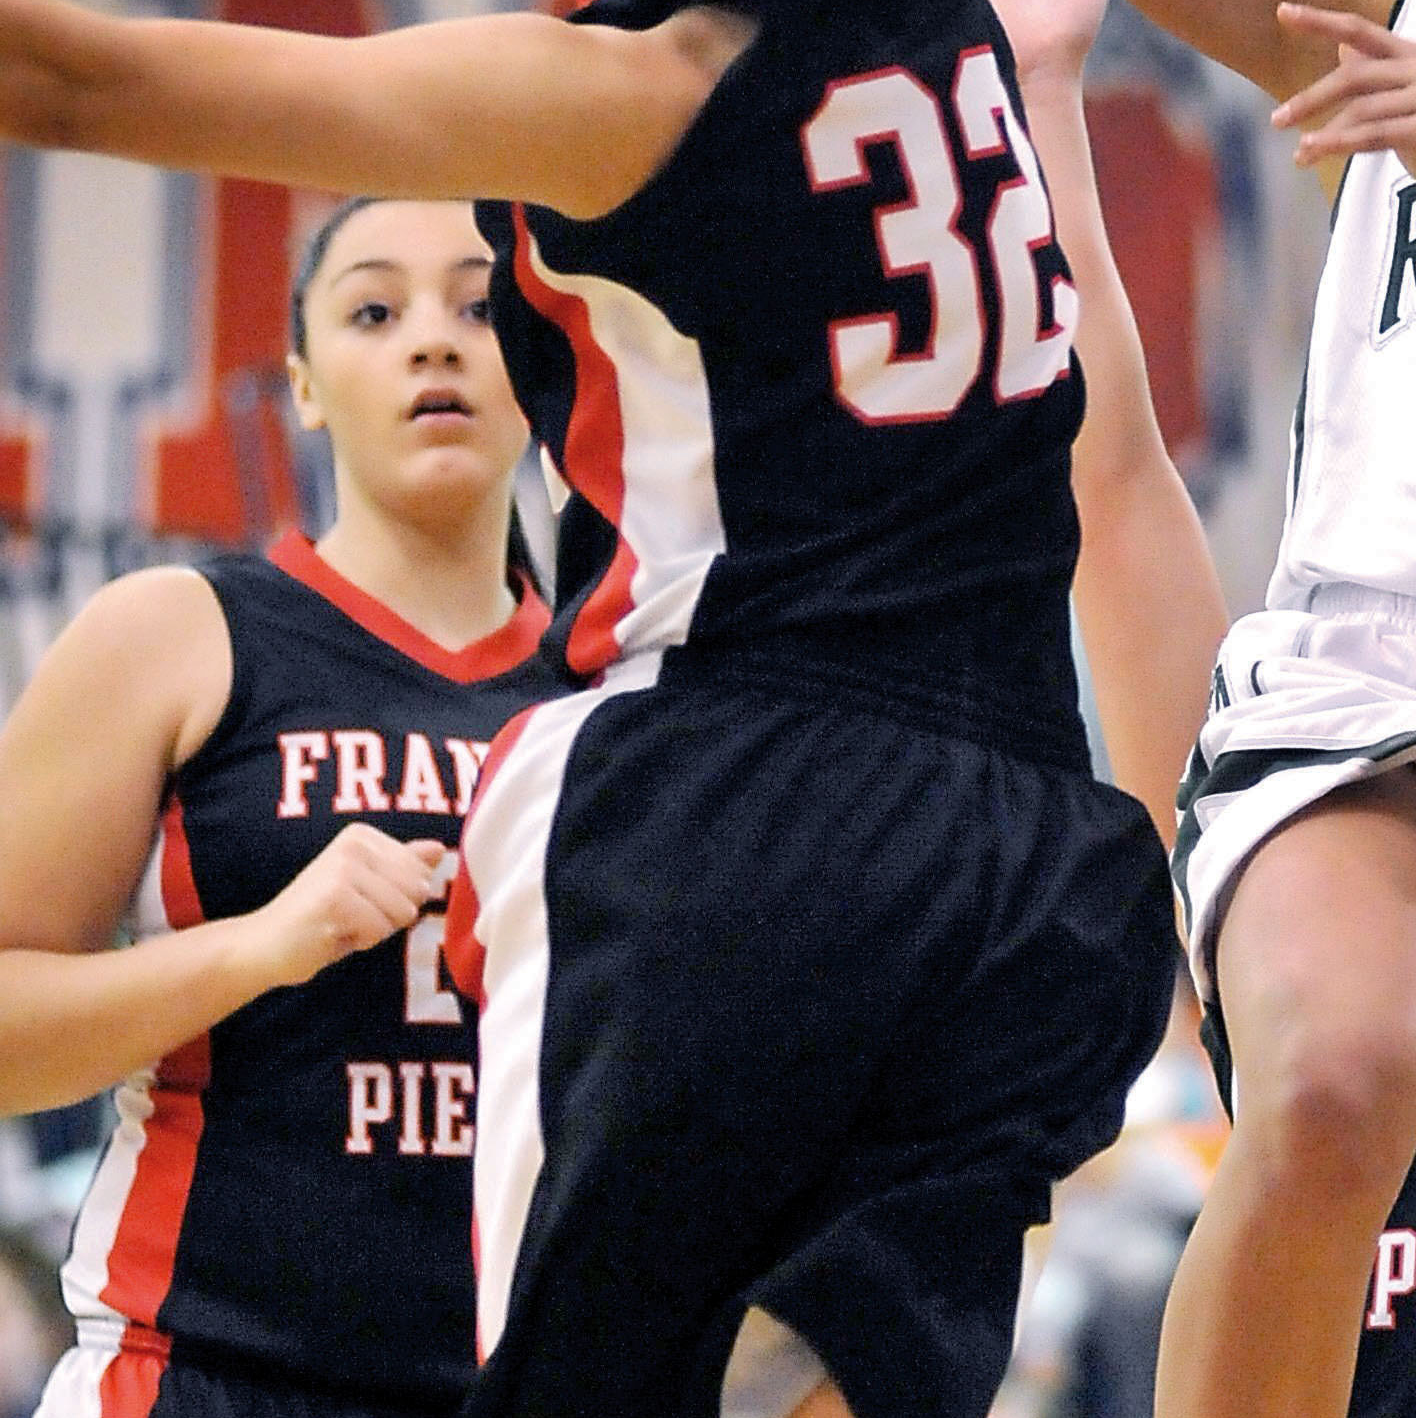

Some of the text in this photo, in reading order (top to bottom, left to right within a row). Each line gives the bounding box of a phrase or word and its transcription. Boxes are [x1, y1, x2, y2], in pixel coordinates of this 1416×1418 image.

[801, 43, 1079, 426] 32
[276, 729, 490, 819] FRAN
[344, 1060, 475, 1156] PIE
